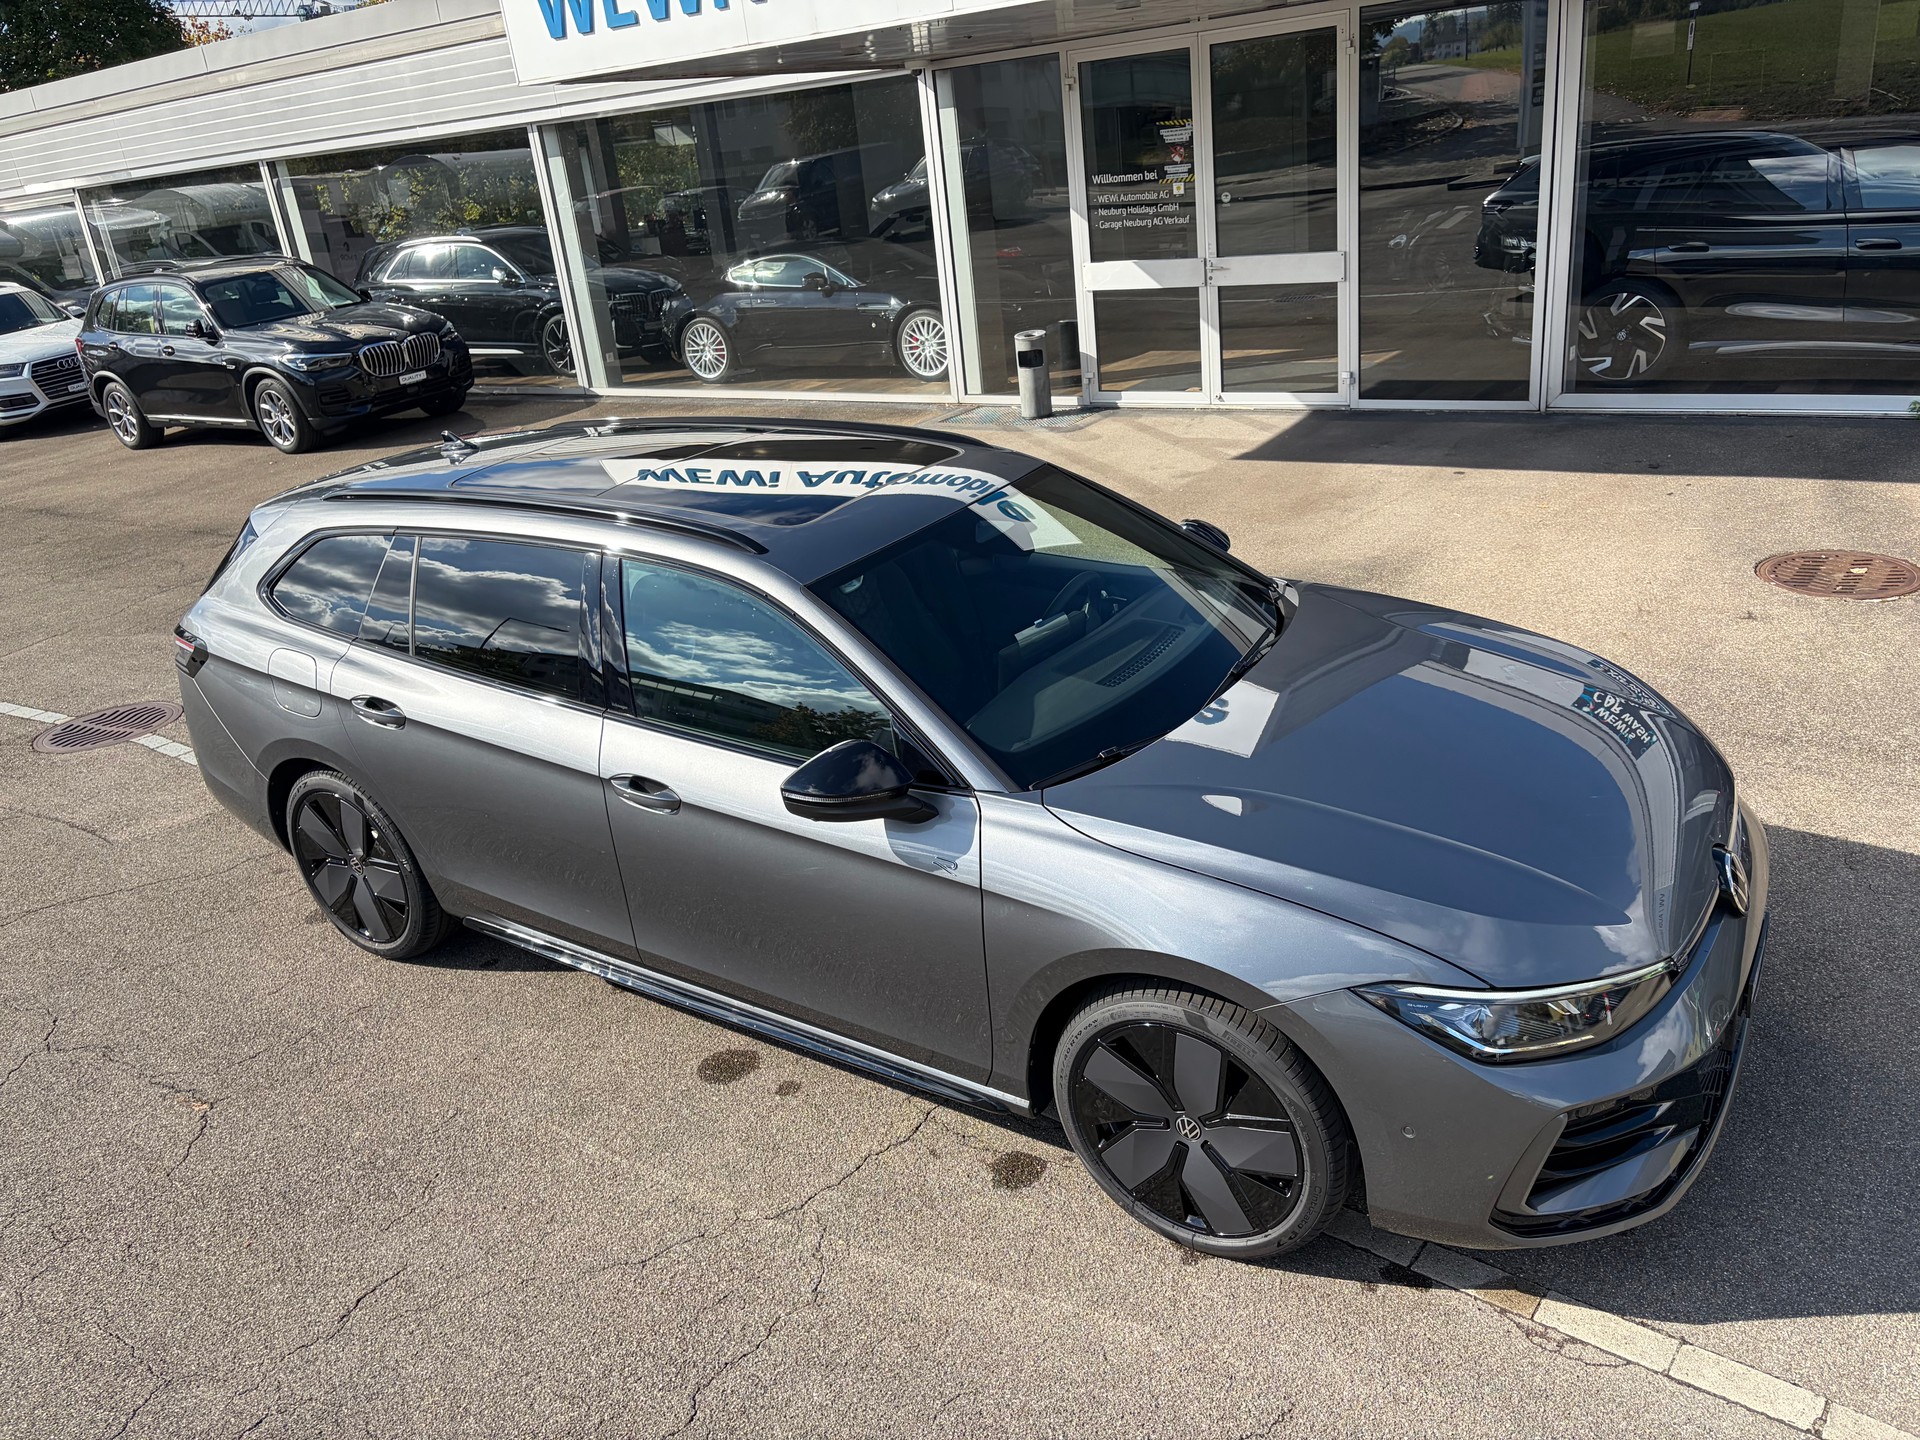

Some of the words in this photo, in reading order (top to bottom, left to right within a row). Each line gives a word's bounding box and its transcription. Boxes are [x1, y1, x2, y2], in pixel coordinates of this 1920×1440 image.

[1092, 172, 1143, 184] Willkommen
[1144, 169, 1158, 180] bei
[1097, 194, 1119, 203] WEWi
[1119, 191, 1157, 202] Automobile
[1158, 190, 1169, 199] AG
[1098, 207, 1126, 216] Neuburg
[1127, 205, 1157, 215] Holidays
[1157, 202, 1179, 212] GmbH
[1099, 220, 1123, 230] Garage
[1123, 218, 1152, 228] Neuburg
[1152, 216, 1163, 226] AG
[1163, 214, 1190, 225] Verkauf
